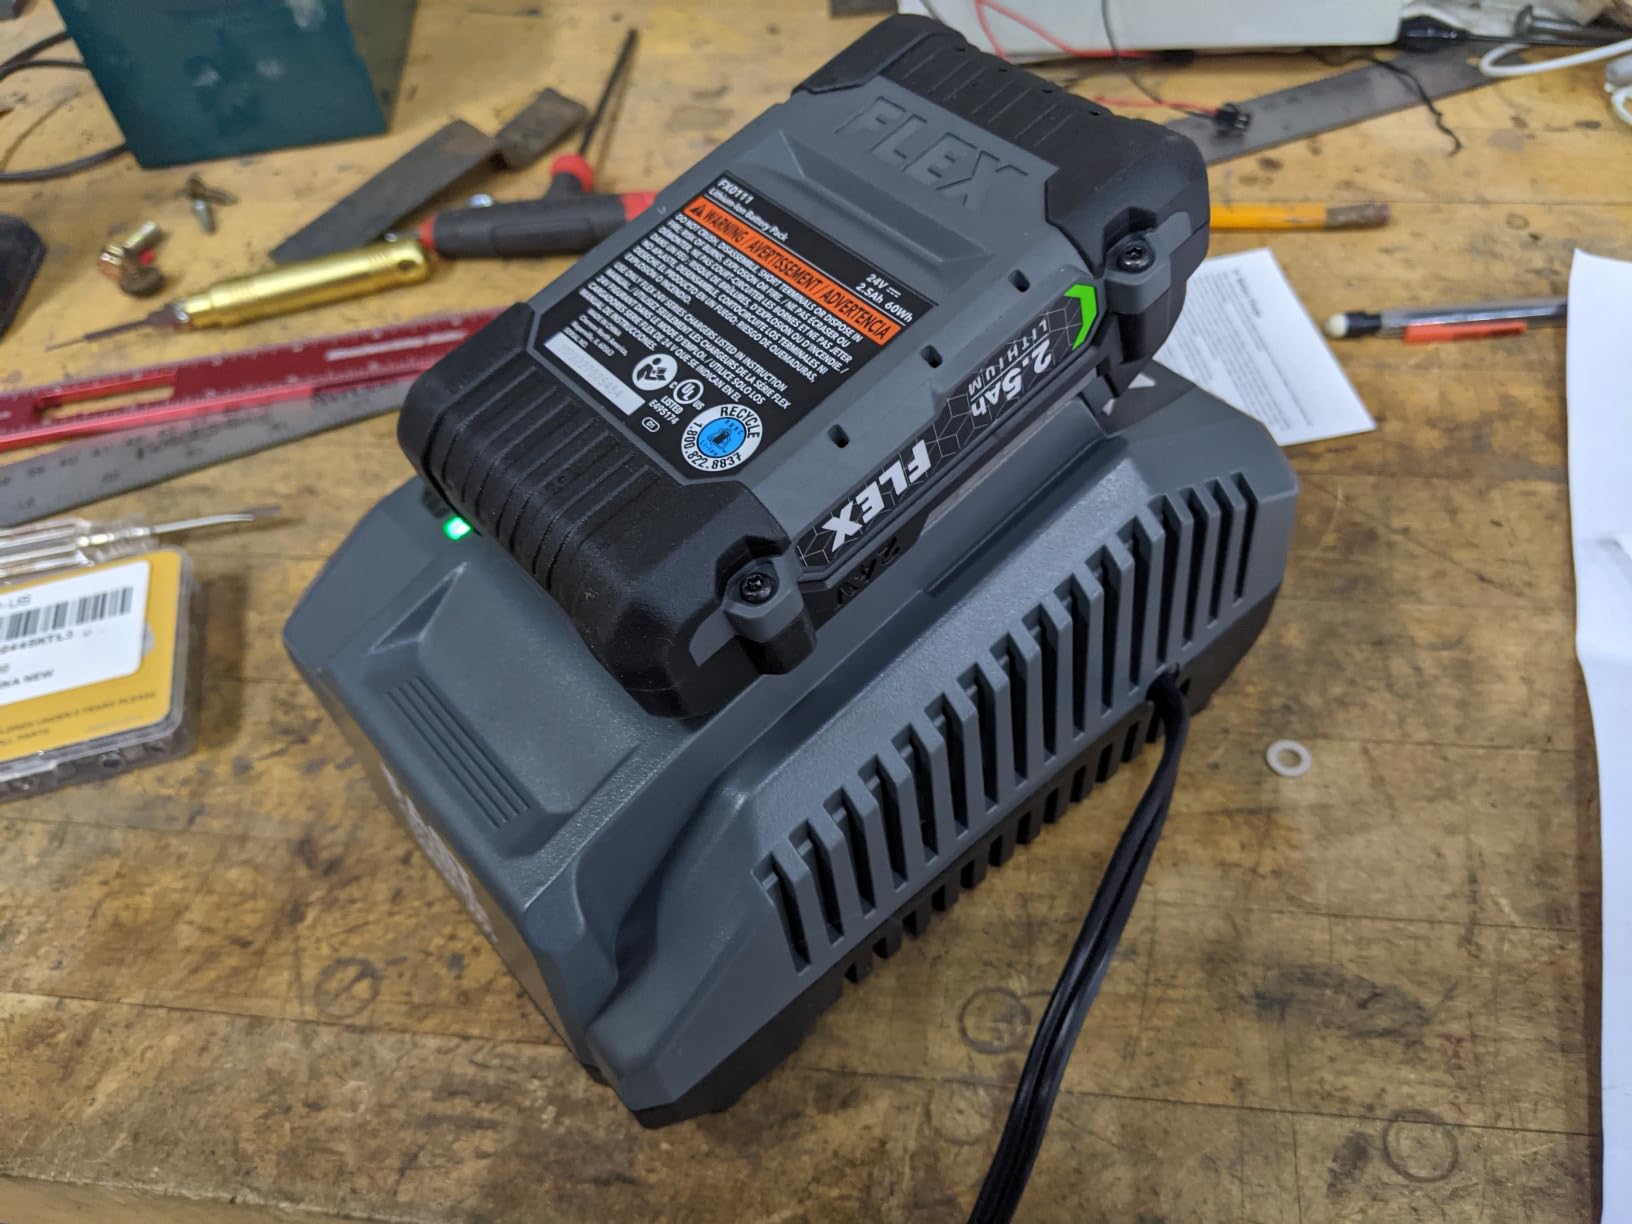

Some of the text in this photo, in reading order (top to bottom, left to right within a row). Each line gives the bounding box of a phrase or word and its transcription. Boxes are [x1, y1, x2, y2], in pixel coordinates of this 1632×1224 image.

[715, 178, 755, 204] FX0111
[833, 96, 1029, 213] FLEX
[741, 209, 773, 231] Battery
[767, 225, 791, 242] Pack
[639, 239, 655, 250] NO
[715, 293, 769, 331] CORTOCIRCUITE
[763, 327, 782, 341] LOS
[776, 336, 821, 369] TERMINALES
[815, 364, 829, 375] NI
[653, 274, 665, 283] O
[674, 213, 689, 223] DO
[755, 268, 782, 287] SHORT
[777, 283, 817, 311] TERMINALS
[811, 306, 827, 318] OR
[822, 313, 855, 337] DISPOSE
[850, 332, 864, 343] IN
[691, 237, 706, 248] OF
[721, 257, 760, 285] EXPLOSION
[754, 280, 770, 292] OR
[764, 287, 785, 302] FIRE.
[784, 300, 798, 311] NE
[793, 307, 811, 320] PAS
[806, 315, 841, 340] ÉCRASER
[835, 335, 851, 348] OU
[698, 254, 715, 266] PAS
[760, 297, 776, 309] LES
[771, 305, 802, 327] BORNES
[797, 323, 811, 334] ET
[805, 329, 820, 340] NE
[815, 335, 833, 349] PAS
[828, 344, 853, 363] JETER
[700, 209, 749, 243] WARNING
[744, 238, 823, 292] AVERTISSEMENT
[818, 287, 894, 339] ADVERTENCIA
[708, 274, 722, 285] DE
[748, 302, 795, 336] D'EXPLOSION
[789, 331, 805, 344] OU
[854, 281, 916, 323] 2.5Ah 60Wh
[864, 272, 889, 290] 24V
[622, 308, 643, 325] SERIE
[637, 320, 657, 336] FLEX
[651, 331, 665, 342] DE
[660, 337, 673, 348] 24
[667, 343, 678, 352] V
[673, 347, 692, 362] QUE
[686, 358, 700, 368] SE
[694, 364, 725, 388] INDICAN
[719, 383, 735, 396] EN
[729, 391, 743, 402] EL
[623, 269, 644, 284] ONLY
[637, 280, 657, 295] FLEX
[651, 290, 669, 303] 24V
[662, 298, 688, 317] SERIES
[682, 312, 718, 340] CHARGERS
[713, 335, 738, 355] LISTED
[733, 350, 746, 361] IN
[740, 356, 788, 392] INSTRUCTION
[631, 288, 660, 310] UTILISEZ
[654, 305, 693, 335] SEULEMENT
[687, 330, 703, 343] LES
[698, 338, 740, 370] CHARGEURS
[734, 365, 749, 377] DE
[743, 372, 757, 384] LA
[751, 378, 776, 397] SÉRIE
[769, 392, 791, 409] FLEX
[632, 303, 654, 319] DANS
[648, 315, 661, 325] LE
[655, 320, 679, 339] MODE
[706, 359, 735, 382] UTILICE
[730, 377, 753, 395] SOLO
[747, 390, 766, 405] LOS
[655, 263, 669, 273] EL
[662, 268, 700, 295] PRODUCTO
[694, 290, 709, 302] EN
[702, 297, 718, 309] UN
[734, 320, 763, 341] RIESGO
[757, 336, 772, 348] DE
[767, 343, 819, 382] QUEMADURAS,
[968, 319, 1048, 393] LITHIUM
[647, 398, 680, 425] E495174
[659, 395, 684, 415] LISTED
[971, 339, 1052, 417] 2.5Ah
[684, 421, 742, 469] 1.800.822.8837
[720, 406, 761, 439] RECYCLE
[821, 439, 932, 552] FLEX
